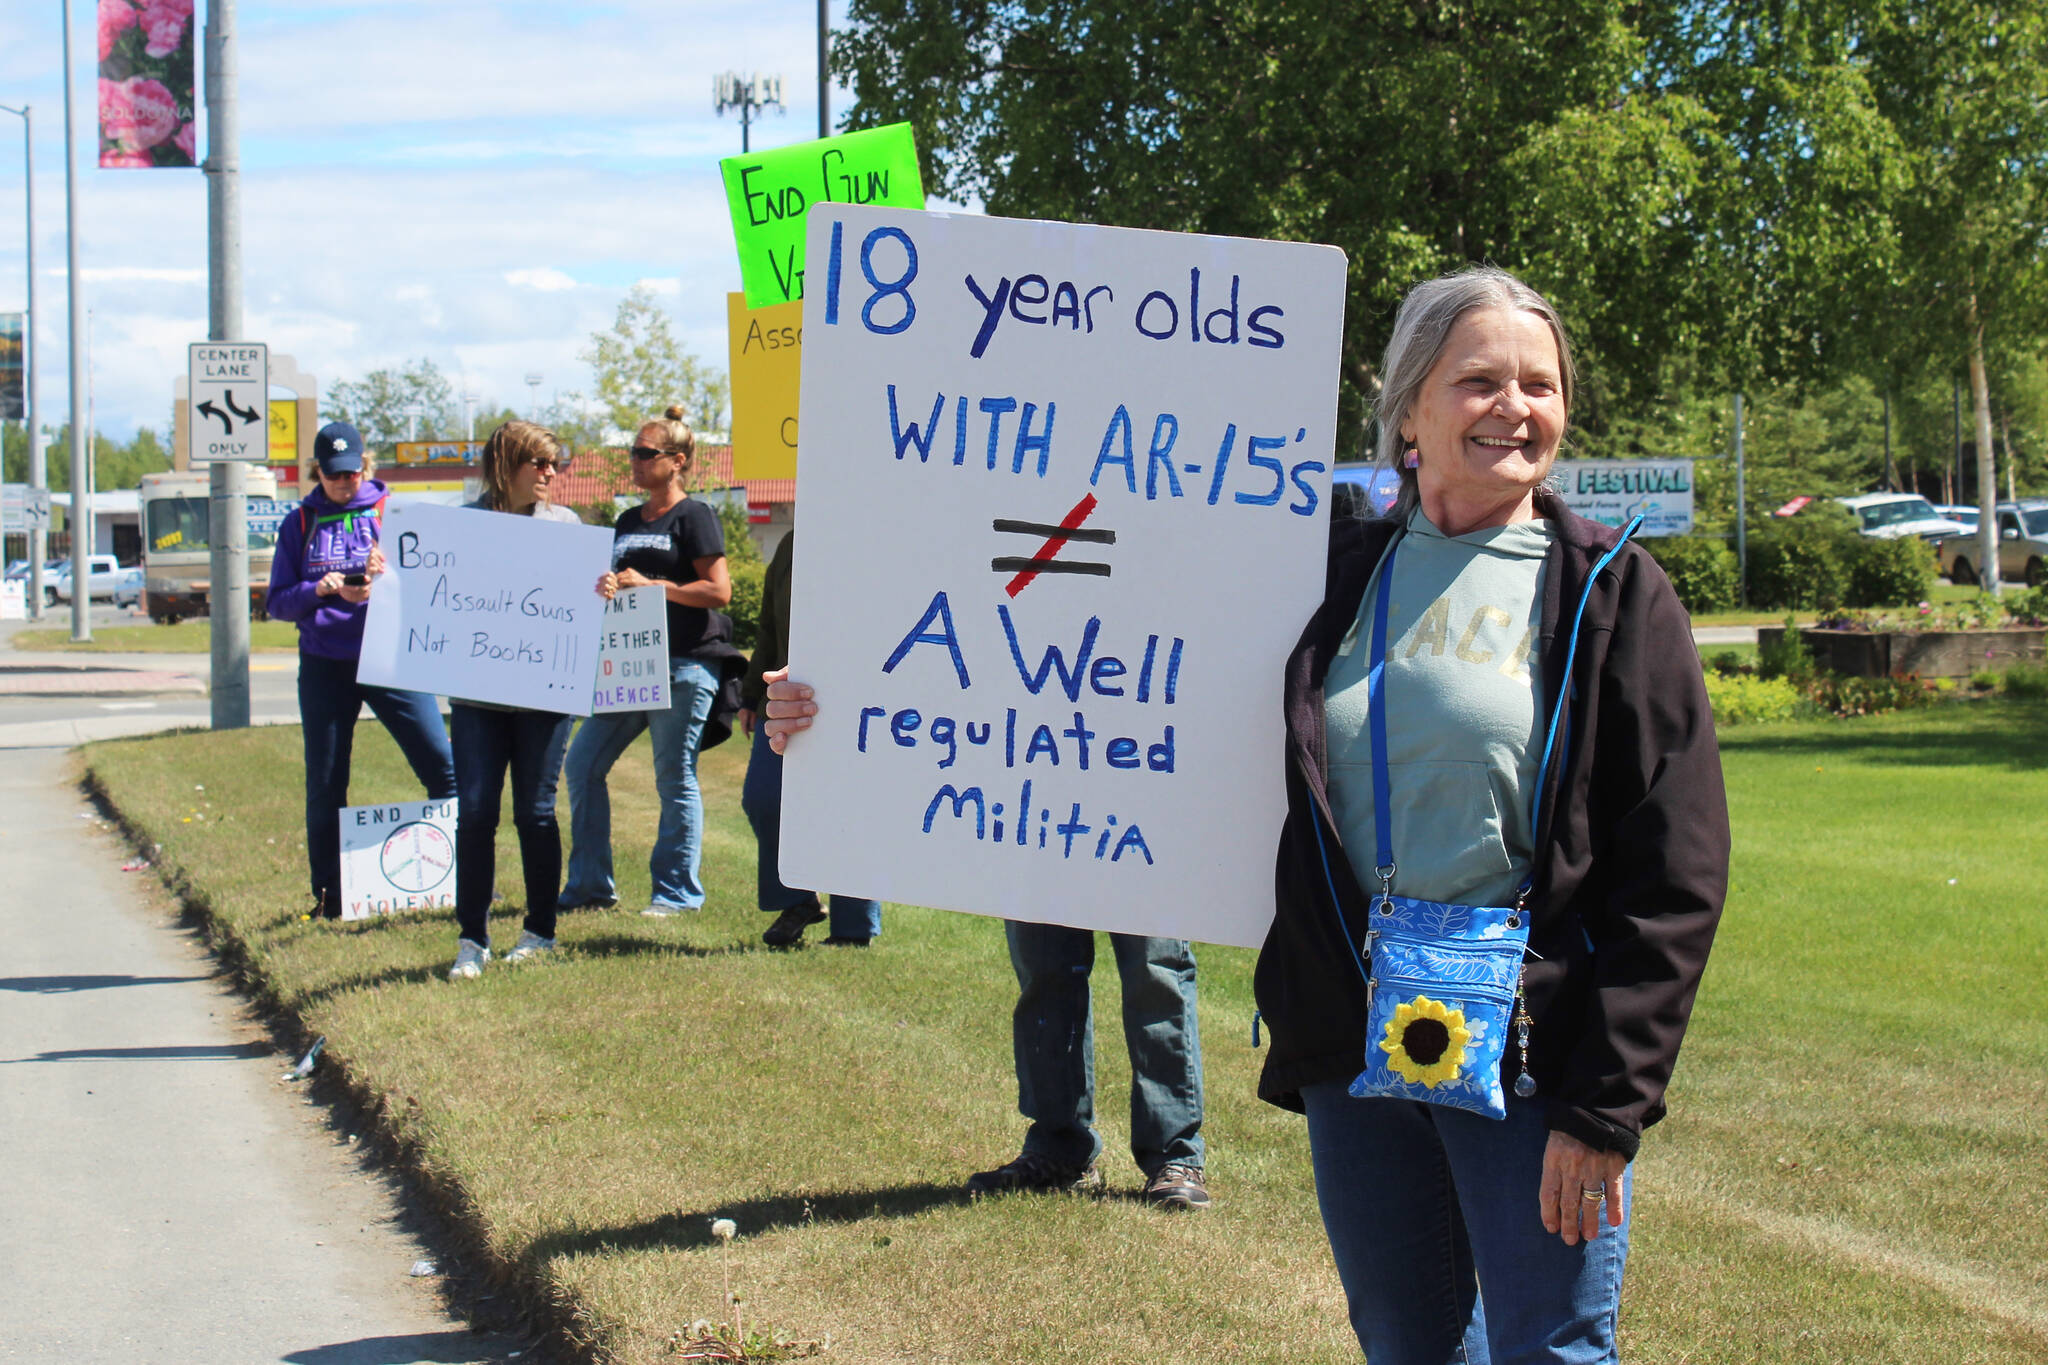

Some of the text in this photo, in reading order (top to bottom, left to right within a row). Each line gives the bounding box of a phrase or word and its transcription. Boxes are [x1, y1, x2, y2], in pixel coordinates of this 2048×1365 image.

[741, 149, 889, 226] END GUN
[825, 220, 918, 335] 18
[1135, 266, 1284, 349] olds
[743, 318, 802, 355] Ass
[198, 350, 258, 360] CENTER
[206, 364, 250, 376] LANE
[887, 384, 1056, 479] WITH
[208, 443, 247, 455] ONLY
[1578, 468, 1690, 494] FESTIVAL
[398, 531, 456, 569] Ban
[430, 574, 576, 622] Assault Guns
[604, 593, 637, 614] ME
[408, 624, 449, 654] Not
[882, 591, 1183, 704] A Well
[622, 659, 656, 677] GUN
[356, 807, 400, 826] END
